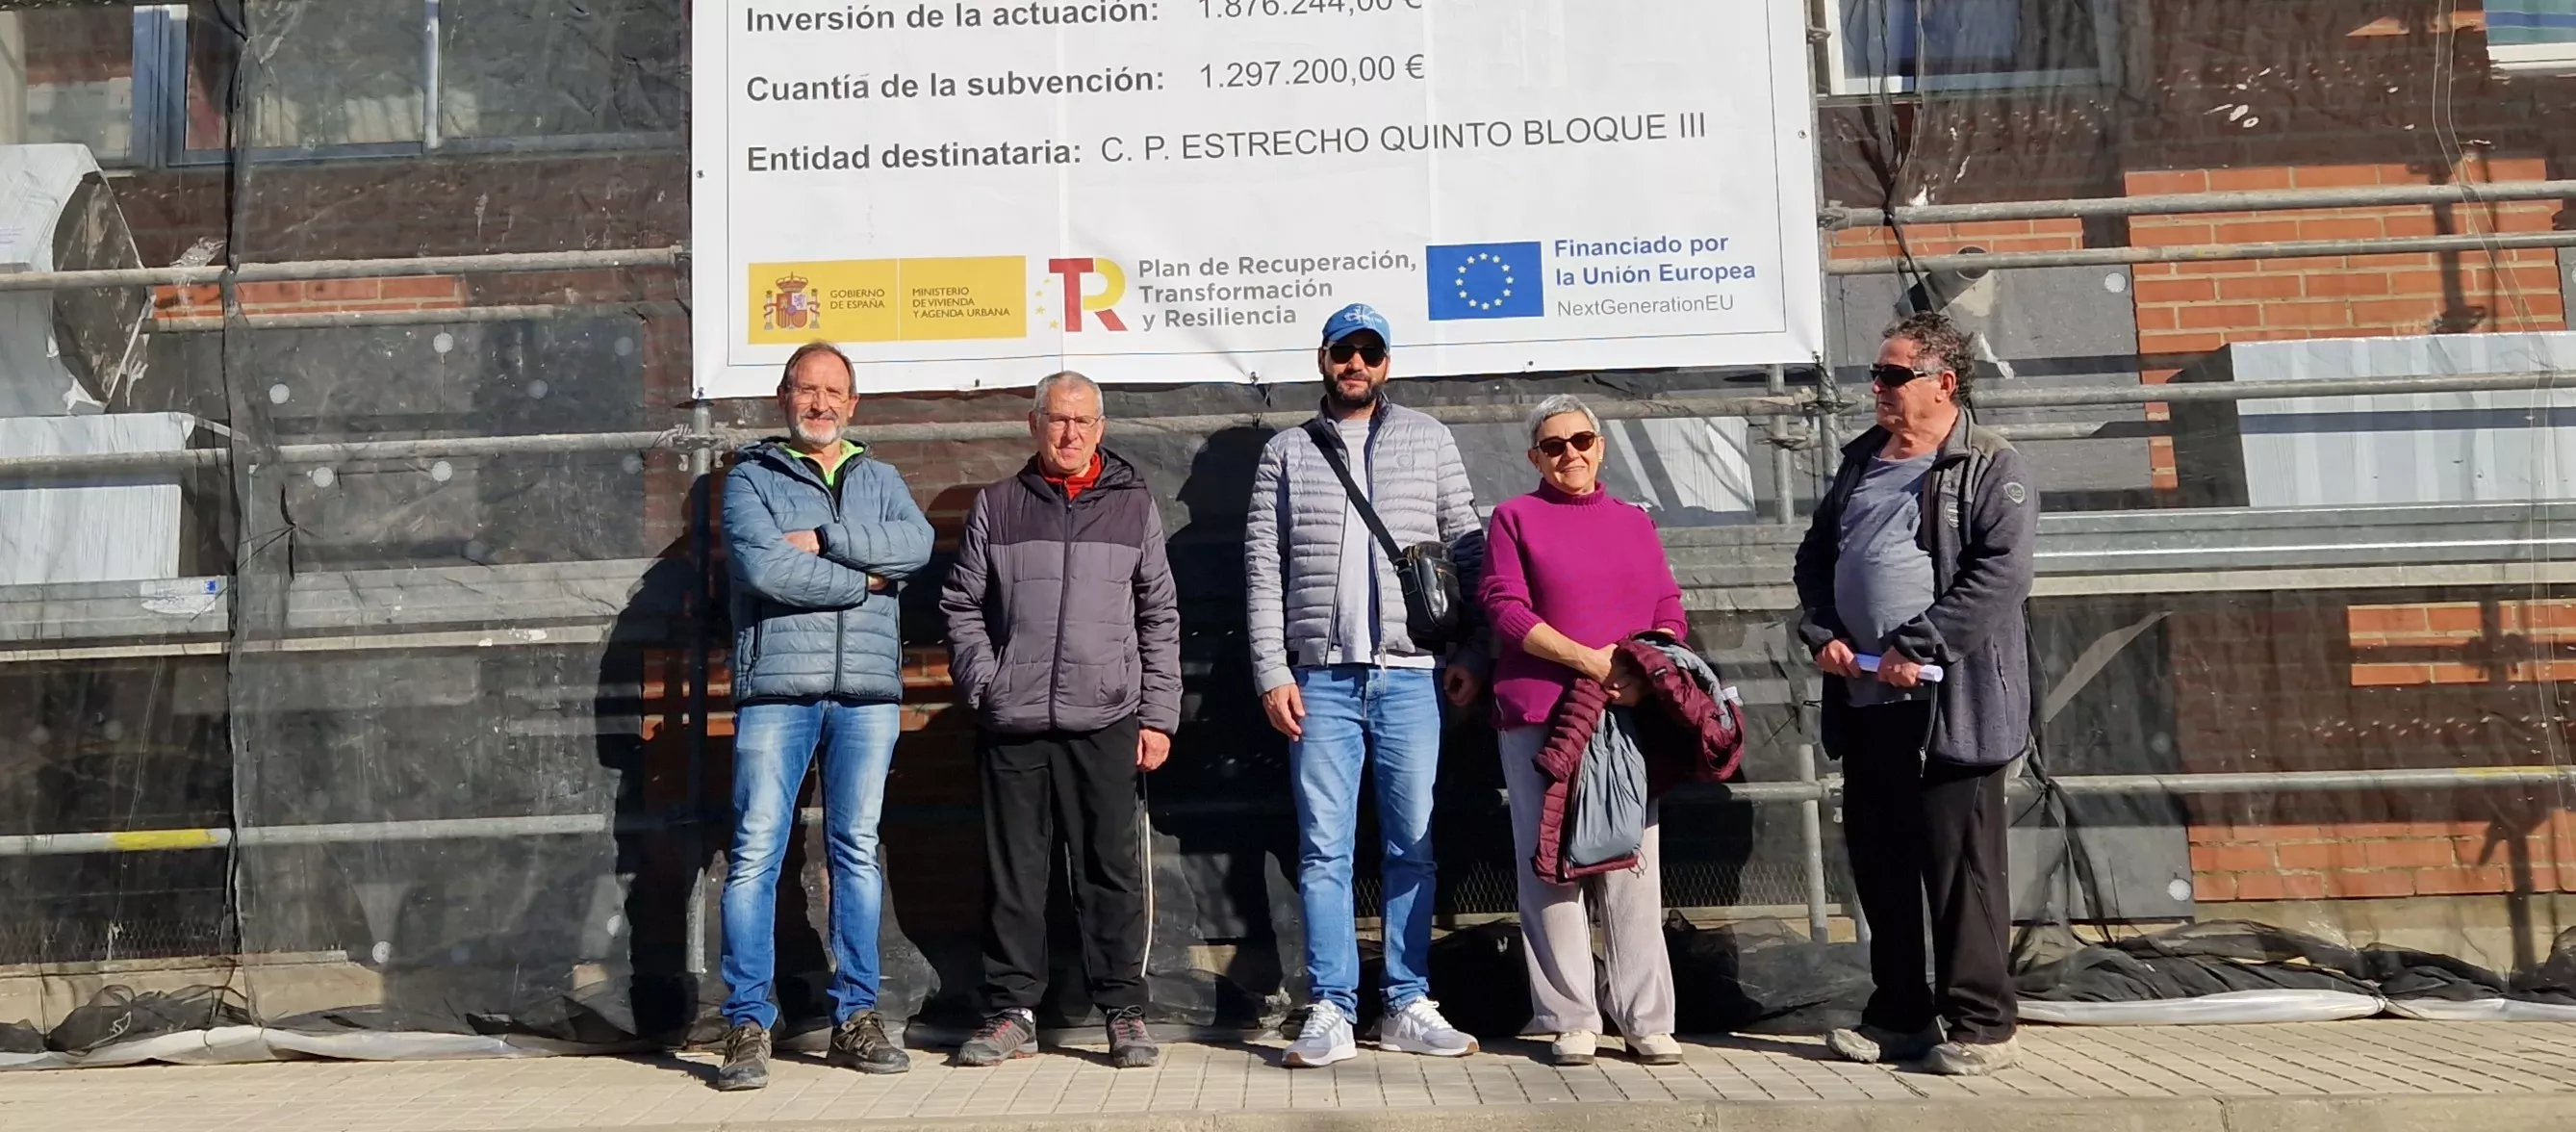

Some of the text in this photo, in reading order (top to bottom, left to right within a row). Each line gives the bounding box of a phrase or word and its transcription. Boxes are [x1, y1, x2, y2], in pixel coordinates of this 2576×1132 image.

[747, 4, 895, 33] Inversión
[905, 3, 945, 29] de
[956, 2, 982, 28] la
[992, 0, 1159, 27] actuación:
[747, 53, 1425, 102] Cuantía de la subvención: 1.297.200,00 €
[748, 113, 1706, 172] Entidad destinataria: C. P. ESTRECHO QUINTO BLOQUE III
[1554, 235, 1729, 258] Financiado por
[1138, 250, 1416, 278] Plan de Recuperación,
[1556, 263, 1756, 287] la Unión Europea
[829, 288, 885, 298] GOBIERNO
[911, 286, 970, 296] MINISTERIO
[912, 297, 975, 307] DE VIVIENDA
[1138, 278, 1333, 303] Transformación
[829, 297, 885, 309] DE ESPAÑA
[912, 307, 1010, 319] Y AGENDA URBANA
[1557, 295, 1734, 317] NextGenerationEU
[1142, 305, 1296, 332] y Resiliencia
